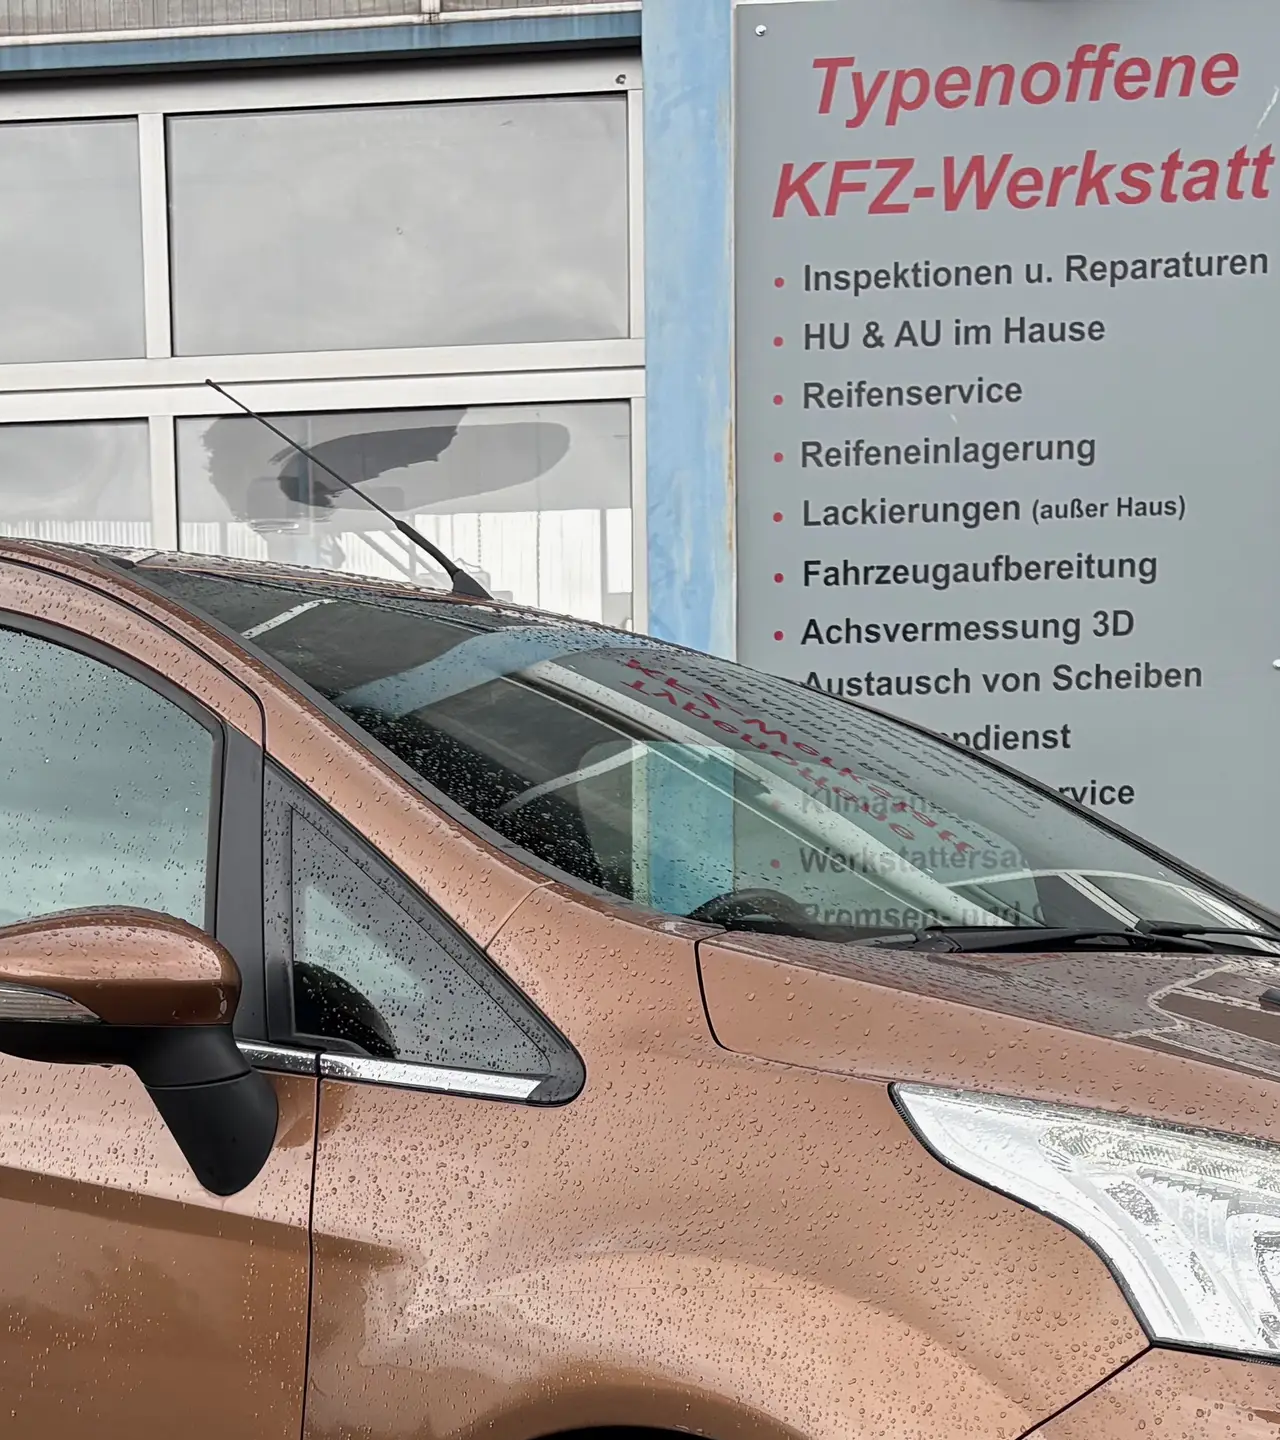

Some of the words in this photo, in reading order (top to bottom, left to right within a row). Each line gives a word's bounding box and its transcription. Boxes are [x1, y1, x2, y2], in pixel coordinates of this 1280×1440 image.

[812, 42, 1240, 129] Typenoffene
[772, 142, 1276, 219] KFZ-Werkstatt
[803, 259, 1013, 296] Inspektionen
[1025, 260, 1053, 284] u.
[1066, 249, 1269, 287] Reparaturen
[803, 323, 850, 351] HU
[863, 321, 885, 349] &
[895, 320, 942, 349] AU
[954, 318, 992, 346] im
[1005, 316, 1106, 344] Hause
[803, 377, 1023, 410] Reifenservice
[801, 436, 1097, 469] Reifeneinlagerung
[803, 498, 1020, 530] Lackierungen
[1032, 499, 1109, 521] (außer
[1117, 495, 1186, 520] Haus)
[803, 553, 1158, 589] Fahrzeugaufbereitung
[801, 613, 1080, 646] Achsvermessung
[1093, 610, 1135, 638] 3D
[806, 668, 971, 697] Austausch
[982, 670, 1041, 695] von
[1052, 663, 1204, 692] Scheiben
[940, 724, 1071, 750] ndienst
